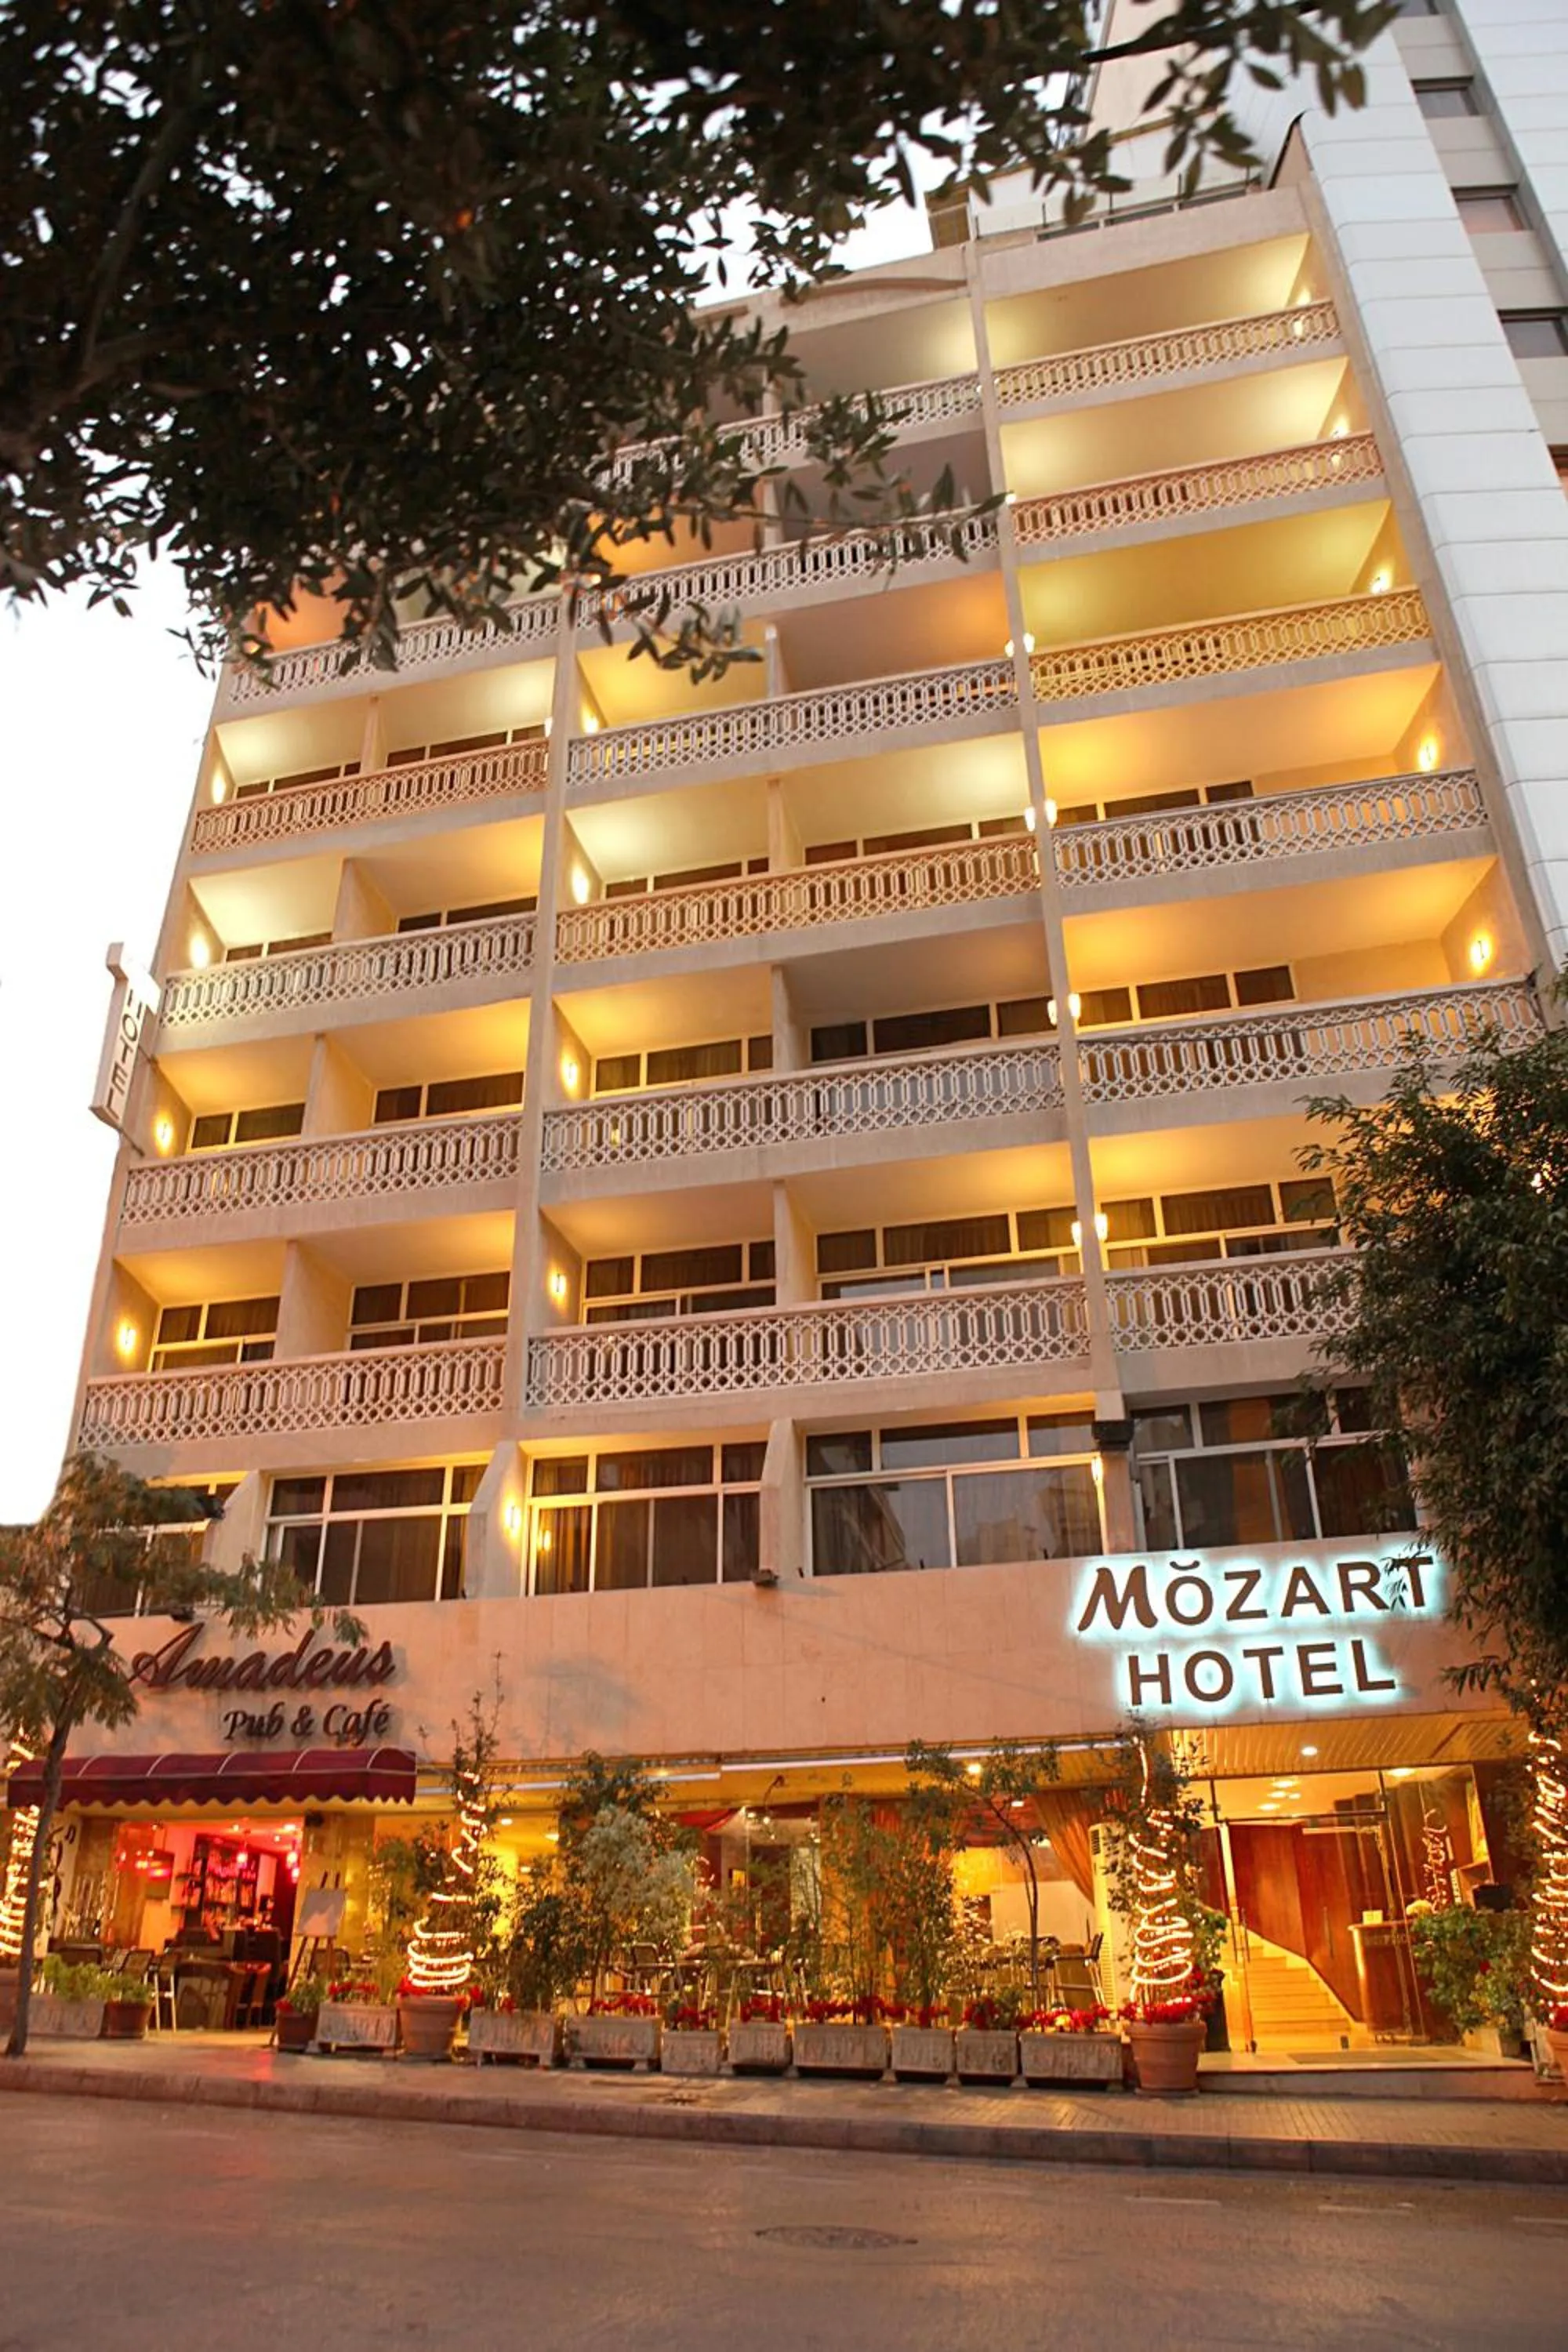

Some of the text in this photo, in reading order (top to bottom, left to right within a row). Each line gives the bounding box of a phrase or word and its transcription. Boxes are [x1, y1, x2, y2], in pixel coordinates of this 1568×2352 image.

[107, 989, 143, 1120] HOTEL
[129, 1622, 396, 1689] Amadeus
[1128, 1639, 1396, 1706] HOTEL
[223, 1699, 390, 1746] Pub & Café
